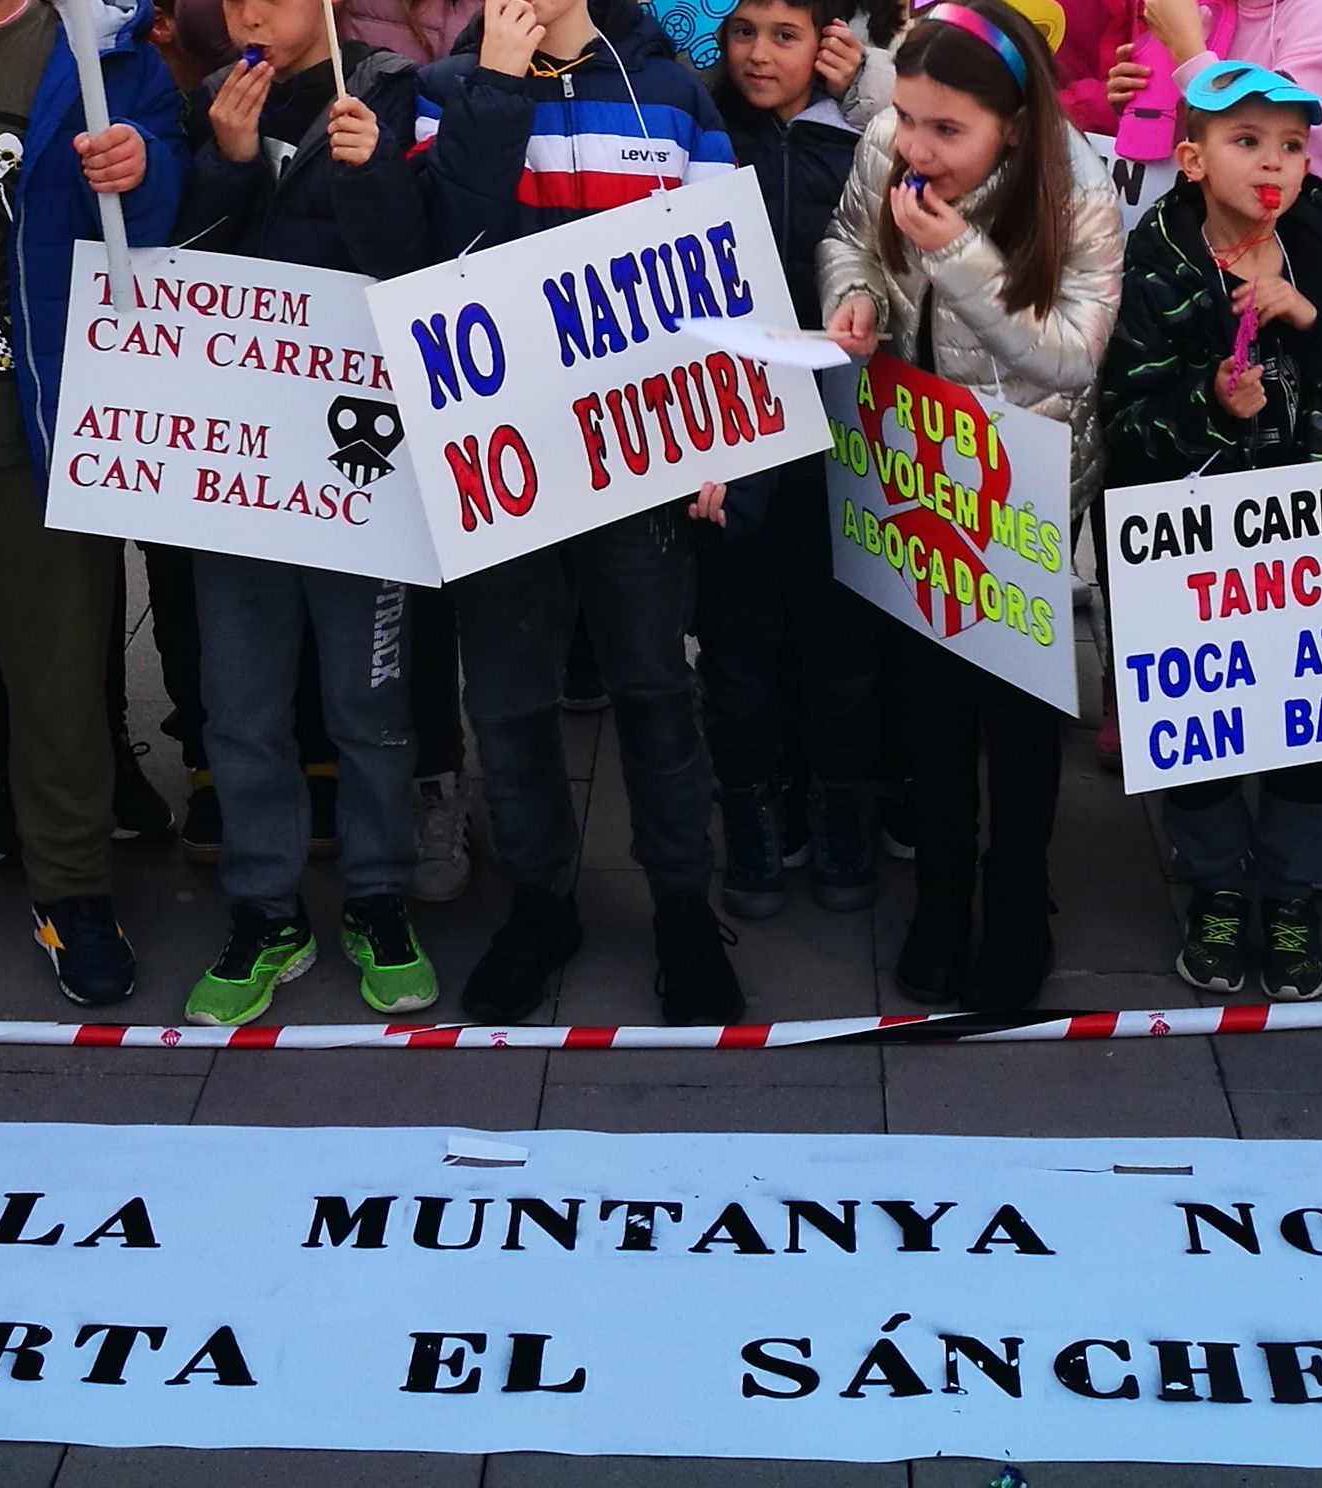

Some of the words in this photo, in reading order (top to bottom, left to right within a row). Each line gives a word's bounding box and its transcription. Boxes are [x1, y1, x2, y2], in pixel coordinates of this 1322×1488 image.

[87, 317, 183, 360] CAN
[410, 301, 506, 411] NO
[543, 220, 754, 367] NATURE
[73, 406, 269, 461] ATUREM
[443, 424, 539, 534] NO
[572, 349, 786, 492] FUTURE
[857, 367, 876, 412] A
[895, 383, 1005, 471] RUBÍ
[68, 451, 164, 496] CAN
[195, 468, 373, 526] BALASC
[829, 416, 869, 478] NO
[874, 440, 980, 533] VOLEM
[989, 500, 1063, 574] MÉS
[1120, 503, 1214, 566] CAN
[842, 499, 1055, 648] ABOCADORS
[1126, 640, 1256, 703] TOCA
[1148, 706, 1245, 771] CAN
[300, 1195, 1056, 1255] MUNTANYA
[398, 1330, 588, 1395] EL
